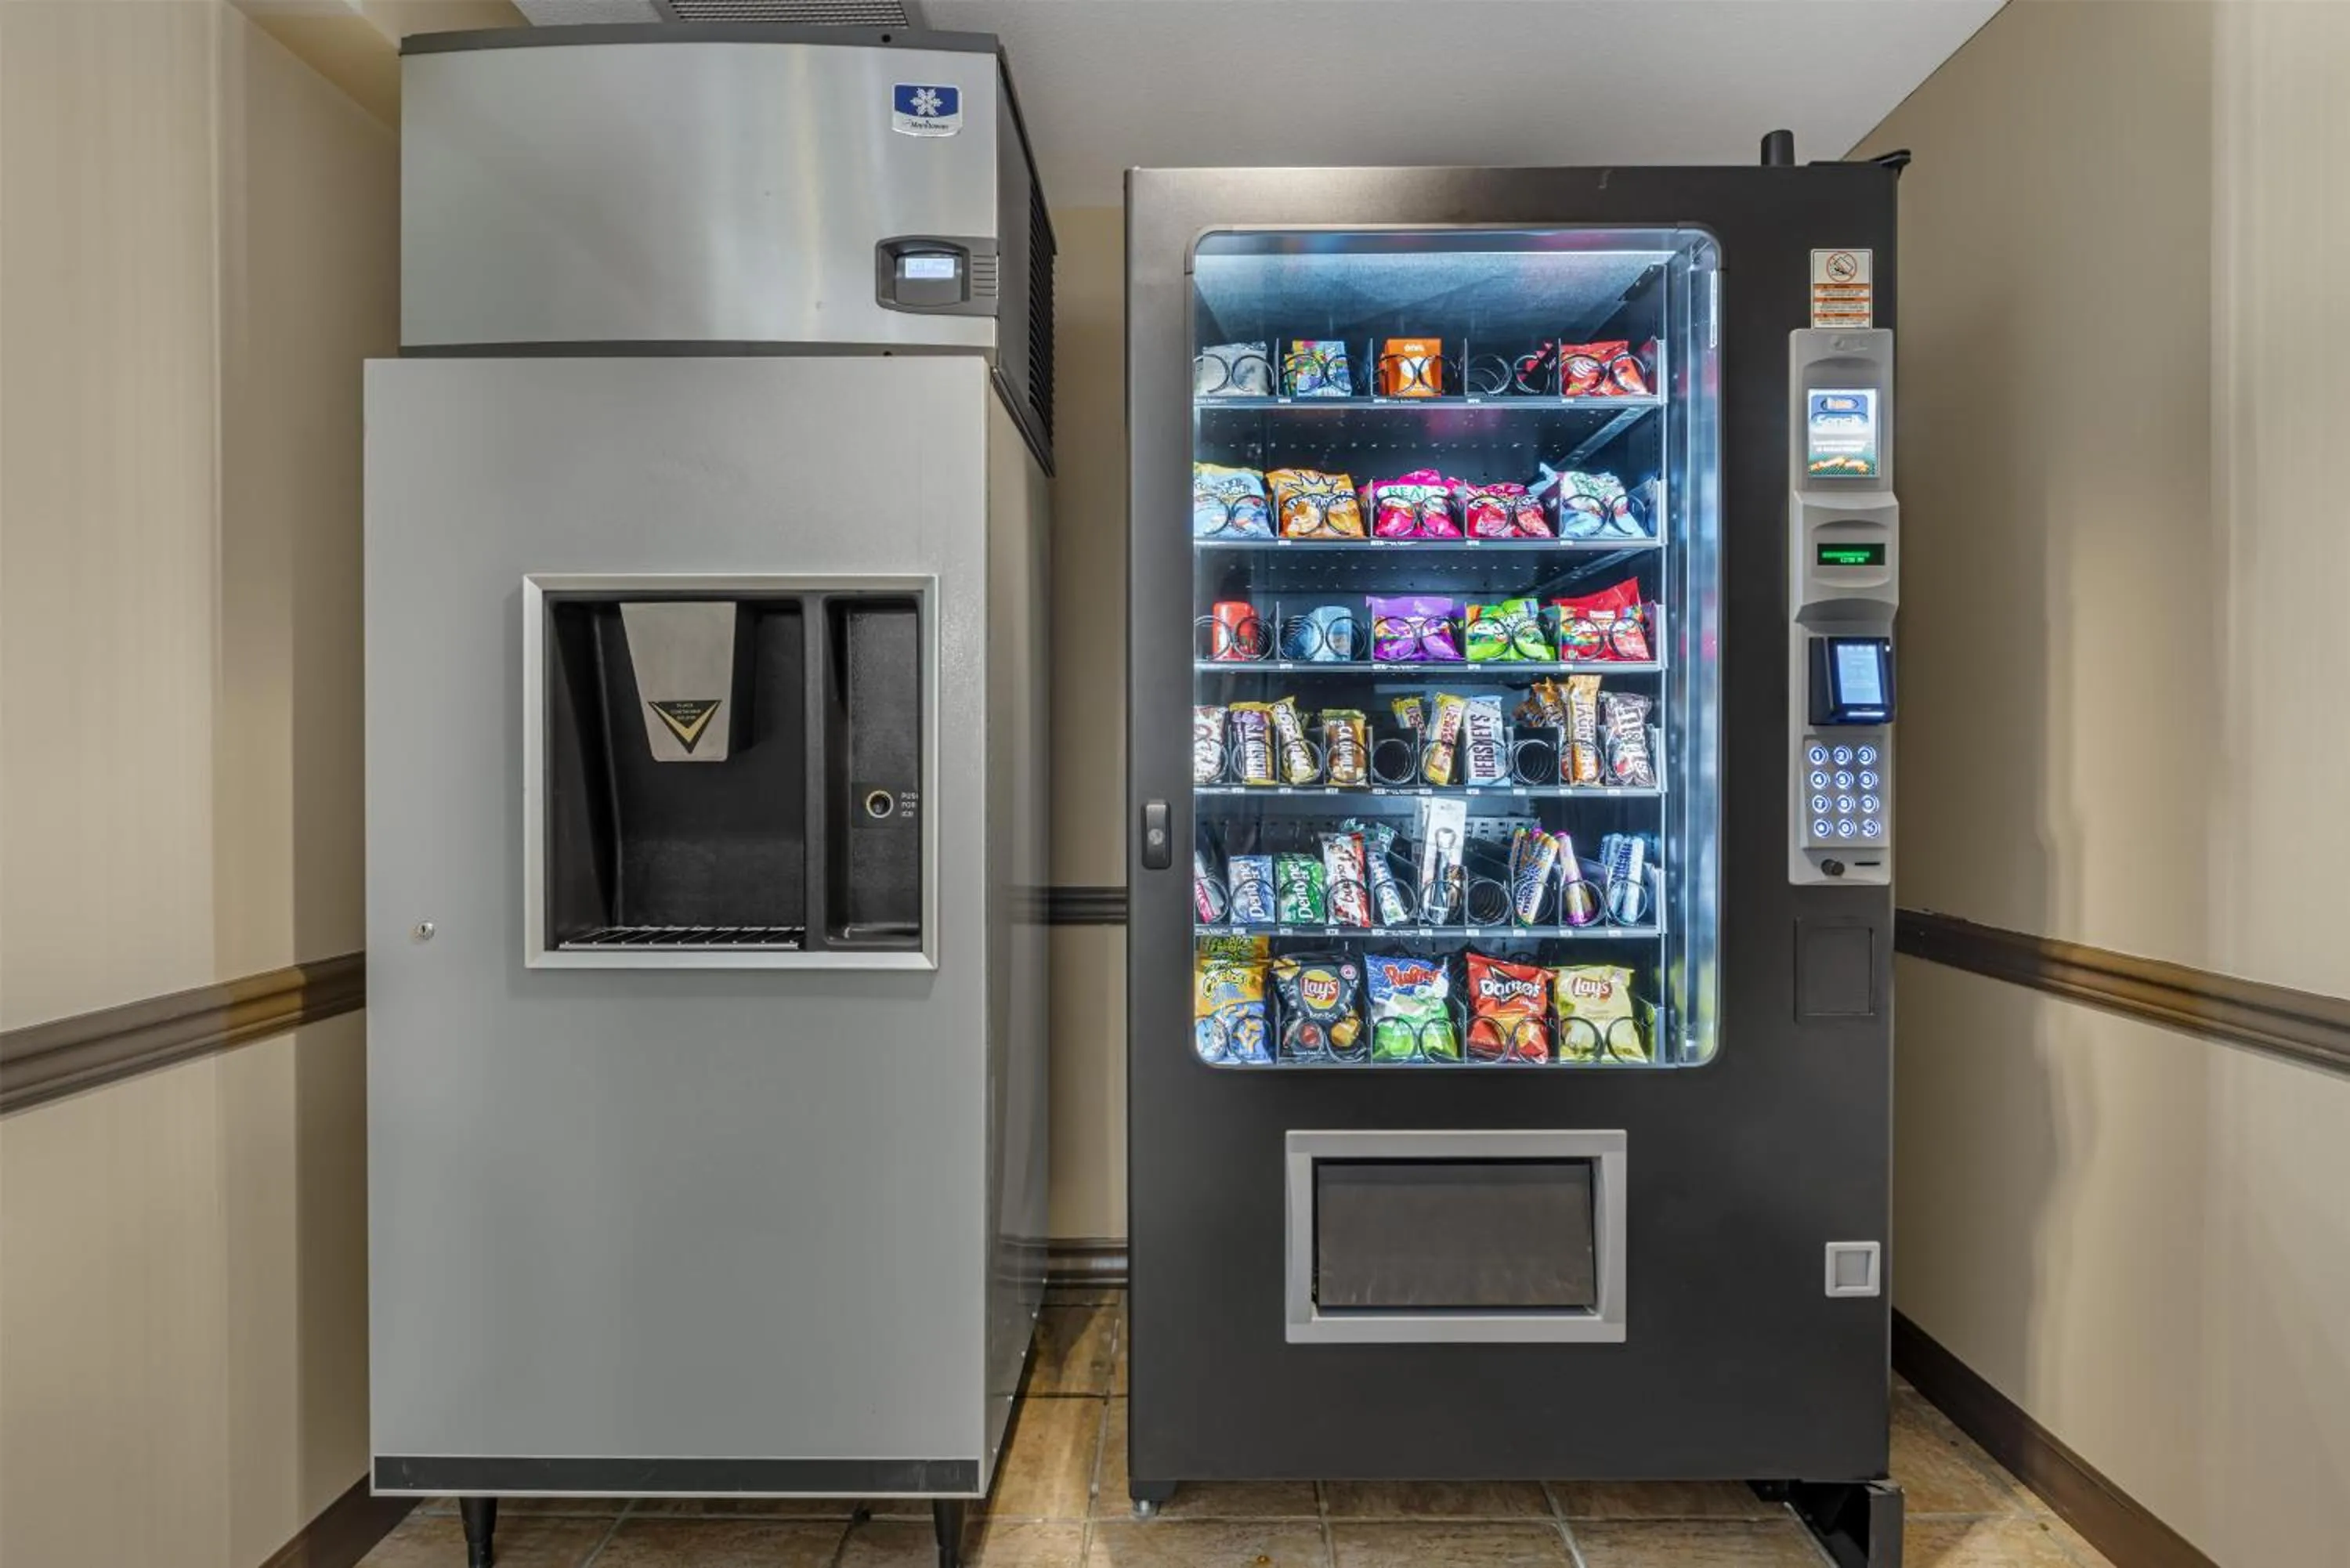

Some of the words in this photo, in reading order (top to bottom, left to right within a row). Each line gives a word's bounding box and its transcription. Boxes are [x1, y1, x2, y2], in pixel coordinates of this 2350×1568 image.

[1470, 714, 1496, 779] HERSHEY'S
[1303, 977, 1336, 1000] Lay's
[1479, 978, 1542, 998] Doritos
[1574, 977, 1611, 999] Lay's
